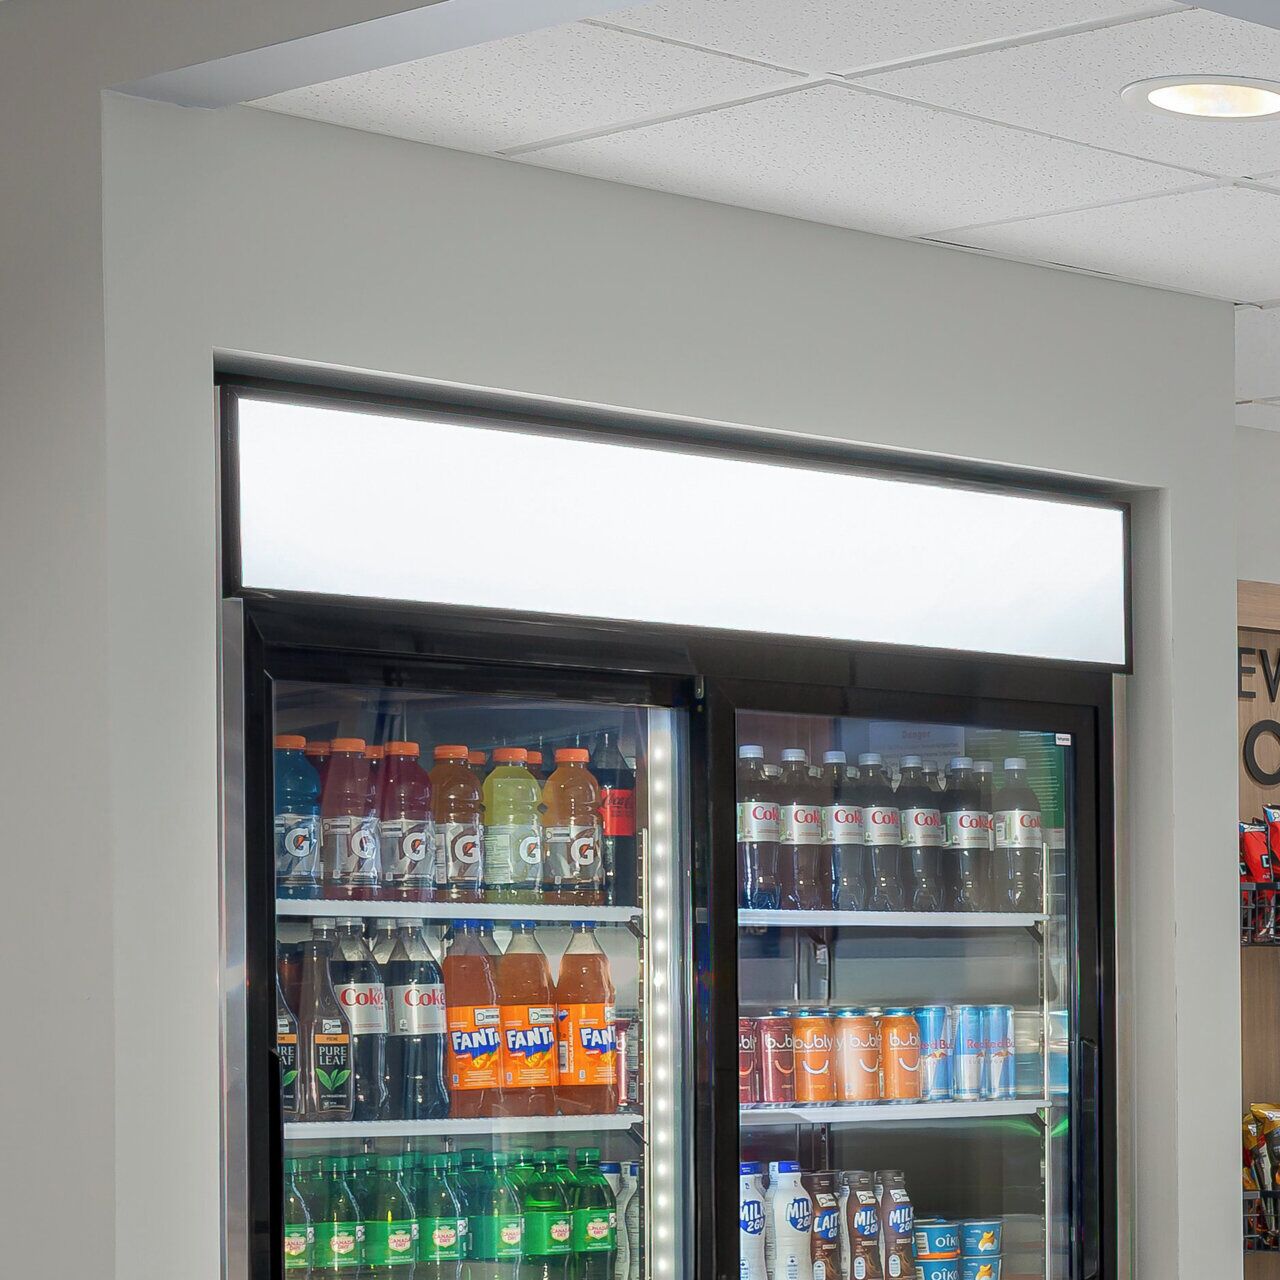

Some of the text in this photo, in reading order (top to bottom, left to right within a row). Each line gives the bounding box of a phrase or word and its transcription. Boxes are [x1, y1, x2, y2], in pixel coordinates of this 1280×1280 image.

[402, 832, 426, 861] G
[455, 833, 481, 864] G
[519, 836, 541, 864] G
[571, 834, 598, 865] G
[404, 988, 446, 1007] Coke
[581, 1026, 616, 1047] FANT
[795, 1033, 834, 1051] bubly
[319, 1046, 347, 1056] PURE
[319, 1056, 347, 1065] LEAF
[786, 1200, 812, 1220] MIL
[747, 1220, 764, 1231] 2GO
